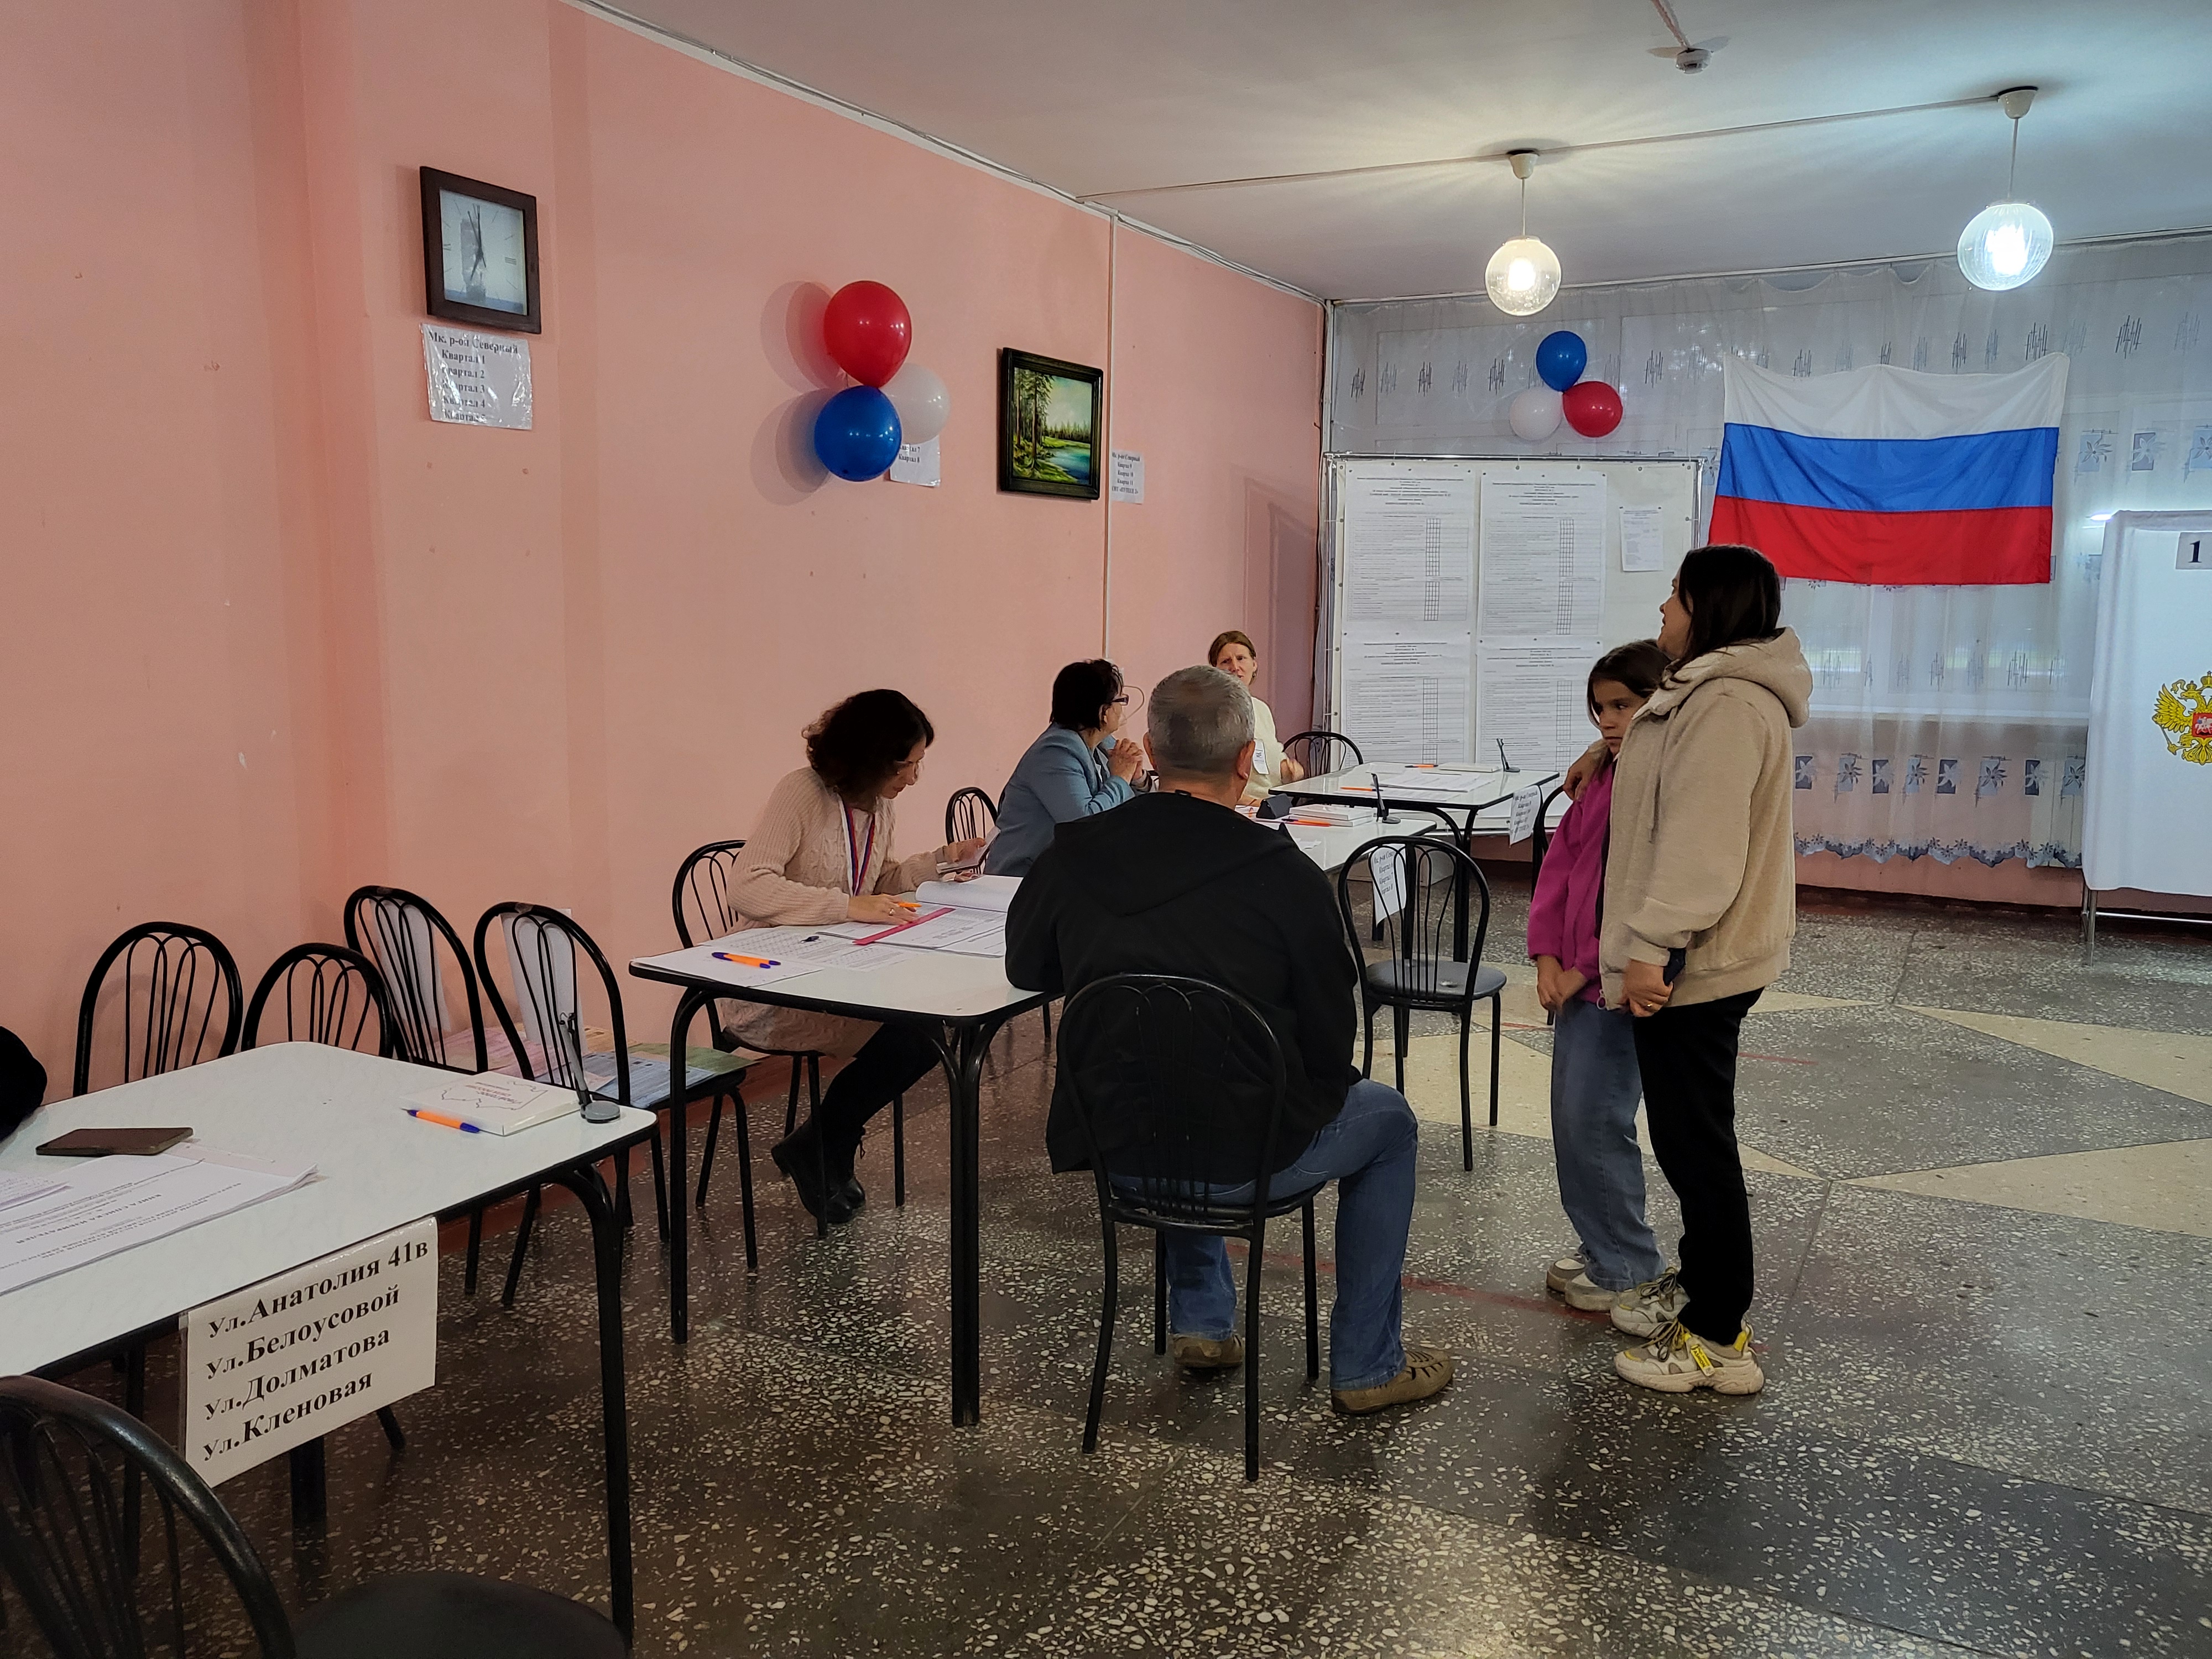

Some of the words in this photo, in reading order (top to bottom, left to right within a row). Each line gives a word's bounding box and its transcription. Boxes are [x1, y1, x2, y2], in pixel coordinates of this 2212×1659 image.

[442, 349, 479, 363] Квартал
[482, 355, 486, 364] 1
[480, 370, 485, 379] 2
[480, 384, 485, 393] 3
[481, 399, 486, 408] 4
[899, 453, 916, 463] Квартал
[2188, 540, 2203, 563] 1
[388, 1241, 429, 1267] 41в
